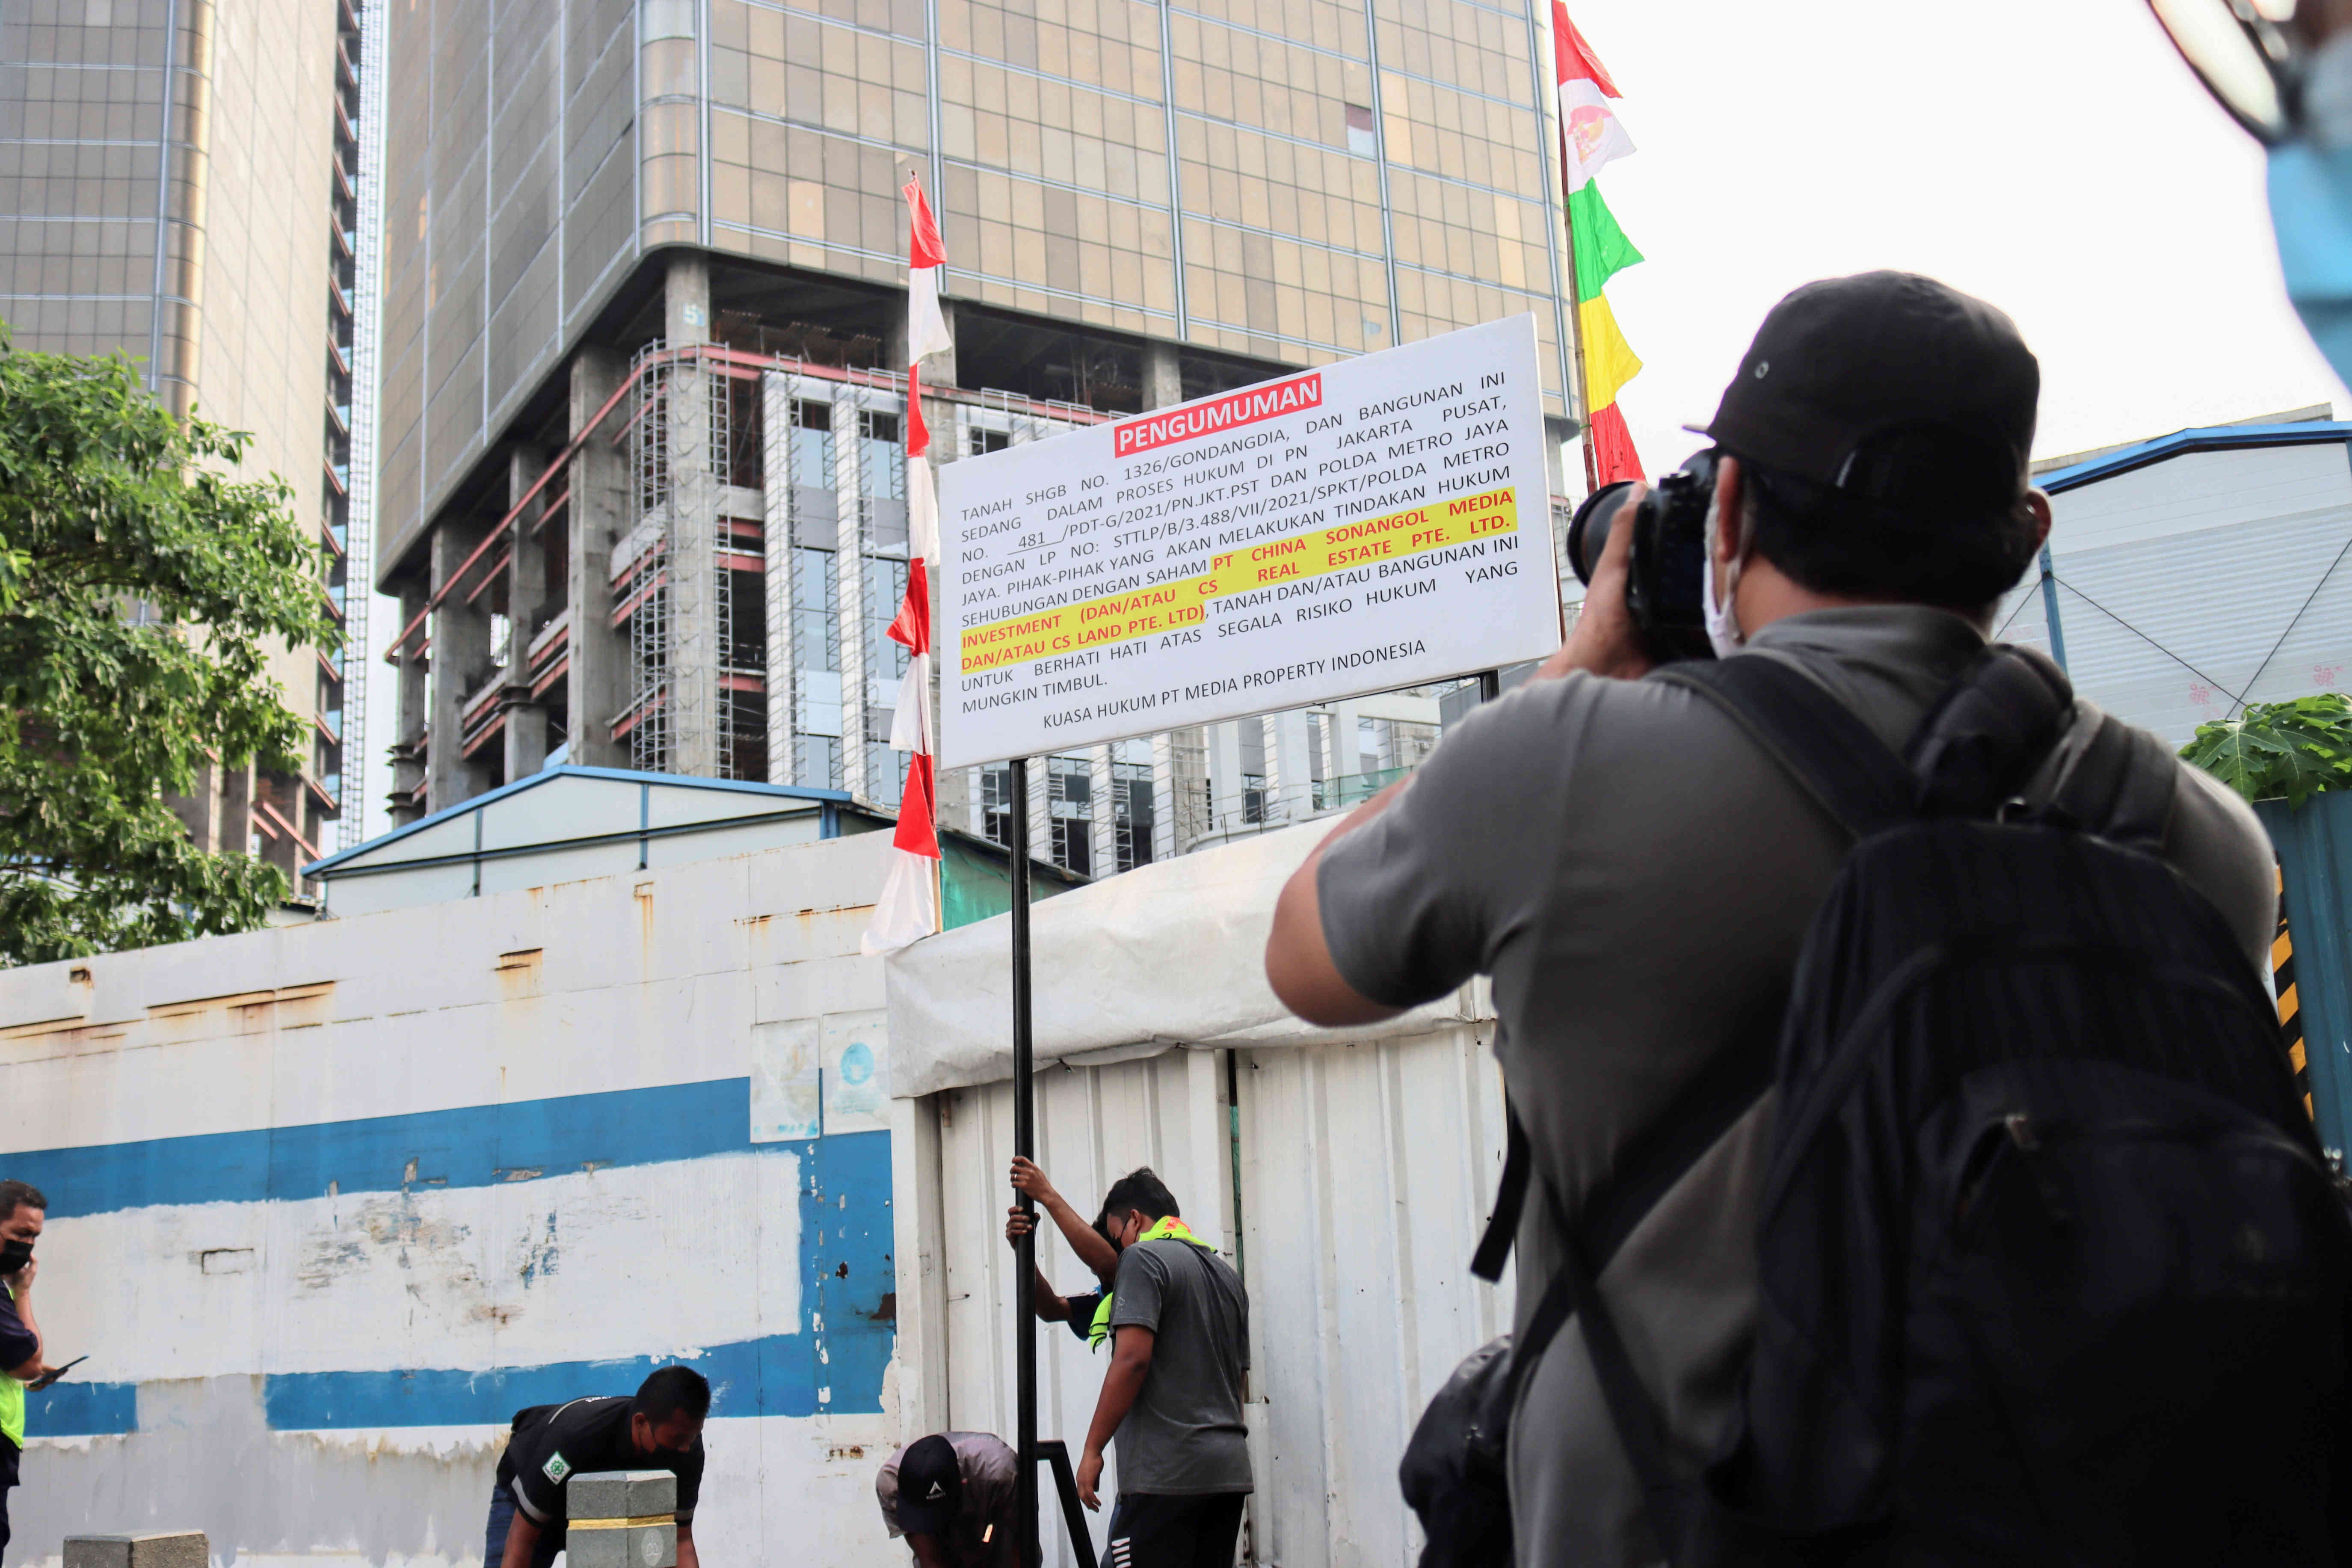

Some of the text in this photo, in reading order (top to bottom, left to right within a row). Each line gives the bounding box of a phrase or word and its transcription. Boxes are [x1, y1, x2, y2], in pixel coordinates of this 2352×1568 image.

[961, 371, 1505, 522] TANAH SHGB NO. 1326/GONDANGDIA, DAN BANGUNAN INI
[961, 395, 1506, 542] SEDANG DALAM PROSES HUKUM DI PN JAKARTA PUSAT,
[1120, 379, 1318, 452] PENGUMUMAN
[961, 465, 1510, 606] JAYA. PIHAK-PIHAK YANG AKAN MELAKUKAN TINDAKAN HUKUM
[962, 548, 989, 563] NO.
[1271, 468, 1306, 488] DAN
[1319, 451, 1377, 476] POLDA
[1388, 432, 1452, 459] METRO
[1464, 419, 1509, 441] JAYA
[963, 442, 1509, 585] DENGAN LP NO: STTLP/B/3.488/VII/2021/SPKT/POLDA METRO
[962, 491, 1513, 628] SEHUBUNGAN DENGAN SAHAM PT CHINA SONANGOL MEDIA
[962, 535, 1518, 670] DAN/ATAU CS LAND PTE. LTD), TANAH DAN/ATAU BANGUNAN INI
[962, 561, 1518, 692] UNTUK BERHATI HATI ATAS SEGALA RISIKO HUKUM YANG
[963, 515, 1510, 649] INVESTMENT (DAN/ATAU CS REAL ESTATE PTE. LTD.
[963, 674, 1107, 714] MUNGKIN TIMBUL.
[1044, 640, 1426, 729] KUASA HUKUM PT MEDIA PROPERTY INDONESIA
